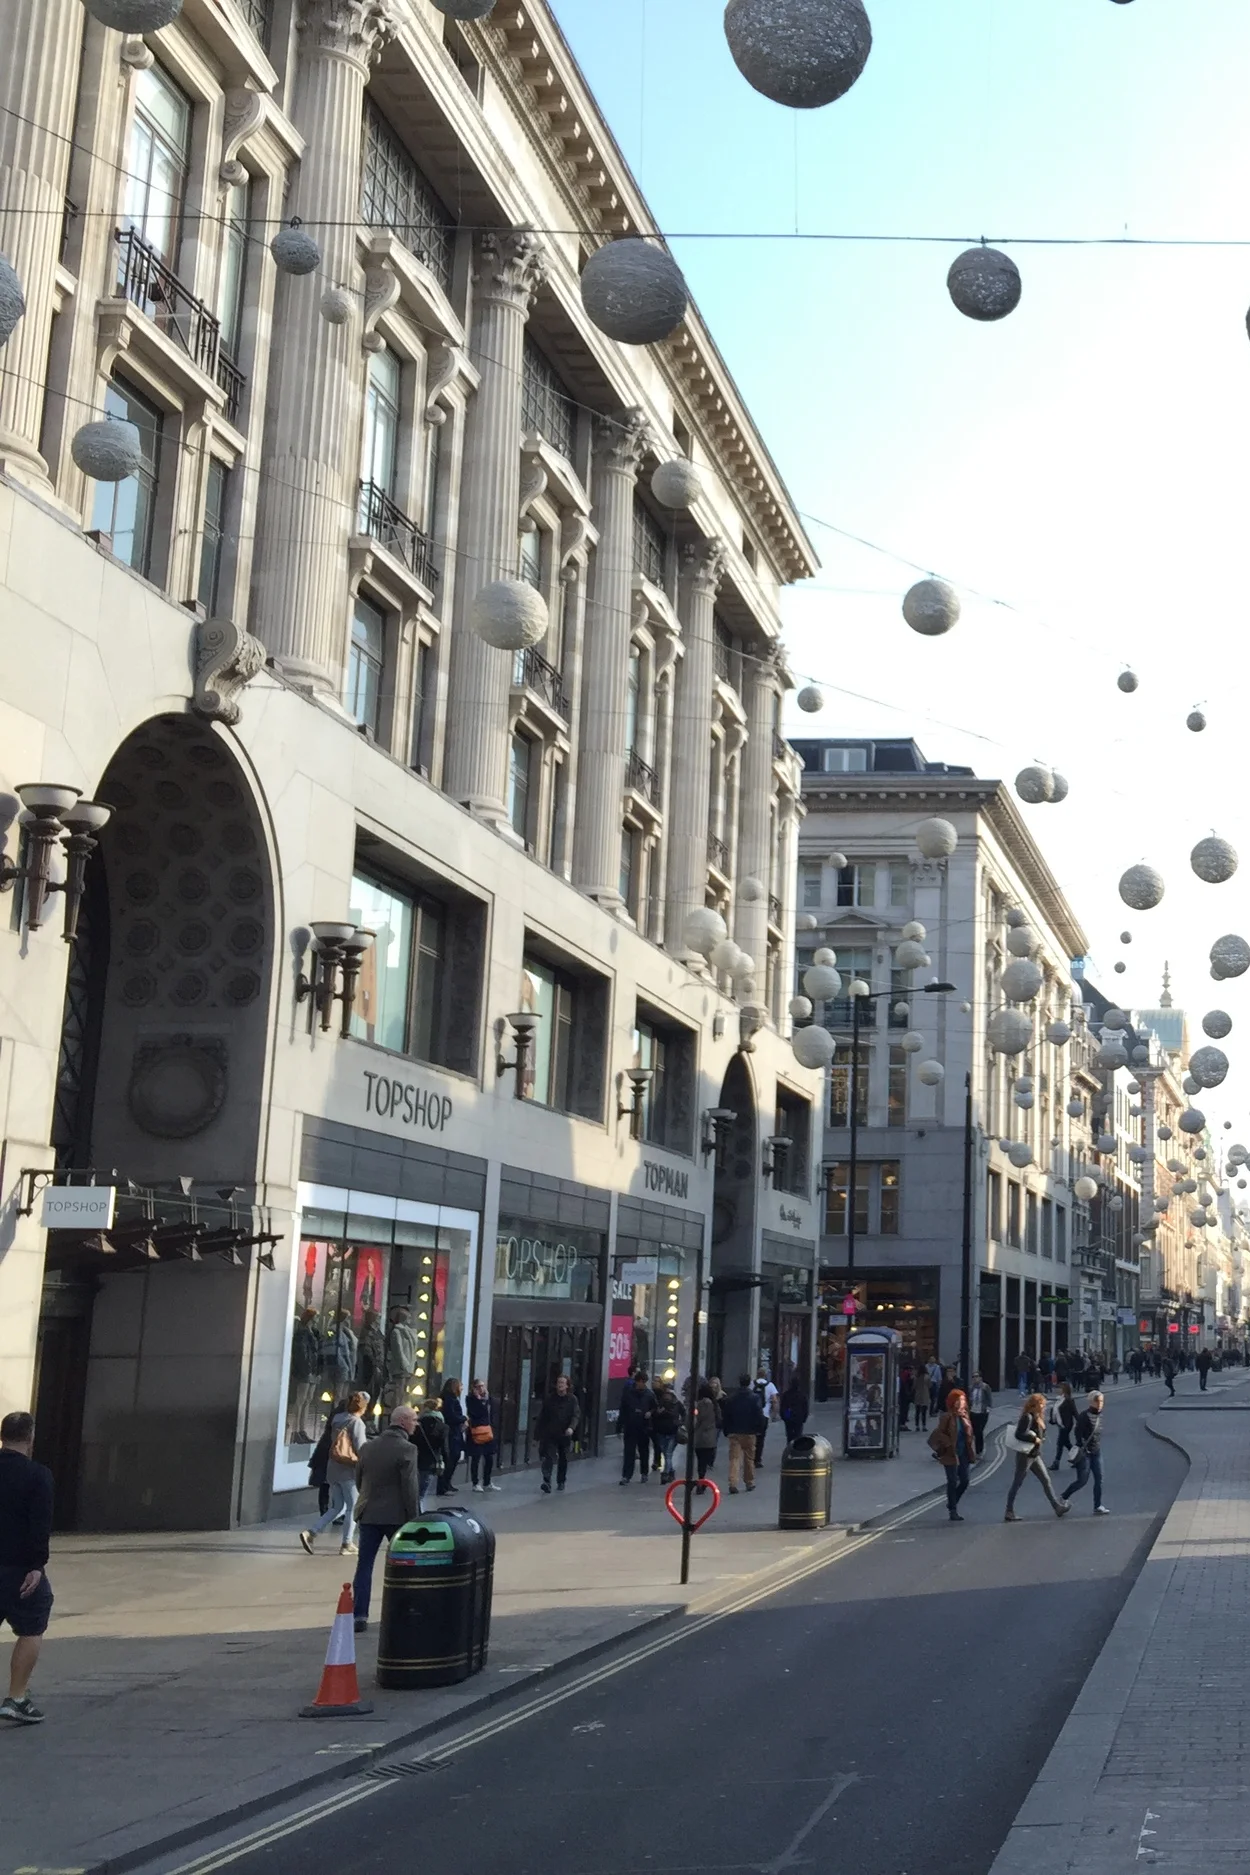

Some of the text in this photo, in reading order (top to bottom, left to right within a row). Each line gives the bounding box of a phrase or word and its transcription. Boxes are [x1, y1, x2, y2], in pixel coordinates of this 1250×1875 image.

[363, 1070, 453, 1132] TOPSHOP
[643, 1160, 689, 1200] TOPMAN
[46, 1201, 107, 1213] TOPSHOP
[497, 1235, 578, 1284] TOPSHOP
[612, 1279, 632, 1300] SALE
